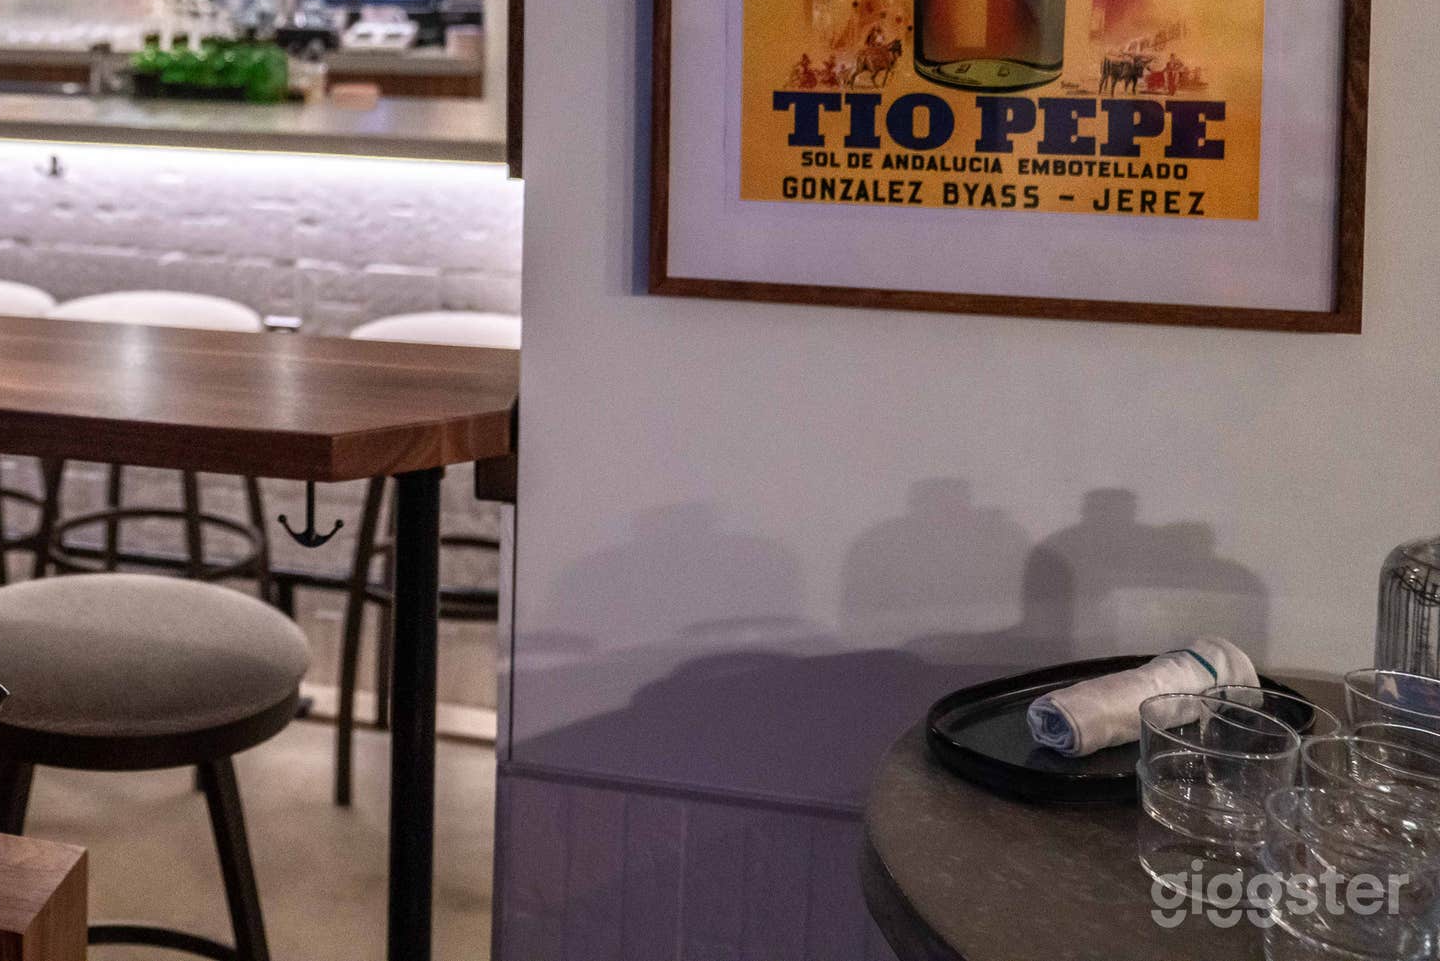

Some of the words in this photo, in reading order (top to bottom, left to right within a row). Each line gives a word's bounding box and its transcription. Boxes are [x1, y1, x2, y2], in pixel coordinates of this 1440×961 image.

[773, 91, 955, 151] TIO
[975, 96, 1226, 160] PEPE
[801, 151, 840, 168] SOL
[847, 152, 873, 169] DE
[881, 153, 1003, 174] ANDALUCIA
[1018, 158, 1189, 180] EMBOTELLADO
[782, 176, 923, 204] GONZALEZ
[943, 182, 1040, 209] BYASS
[1093, 188, 1205, 216] JEREZ
